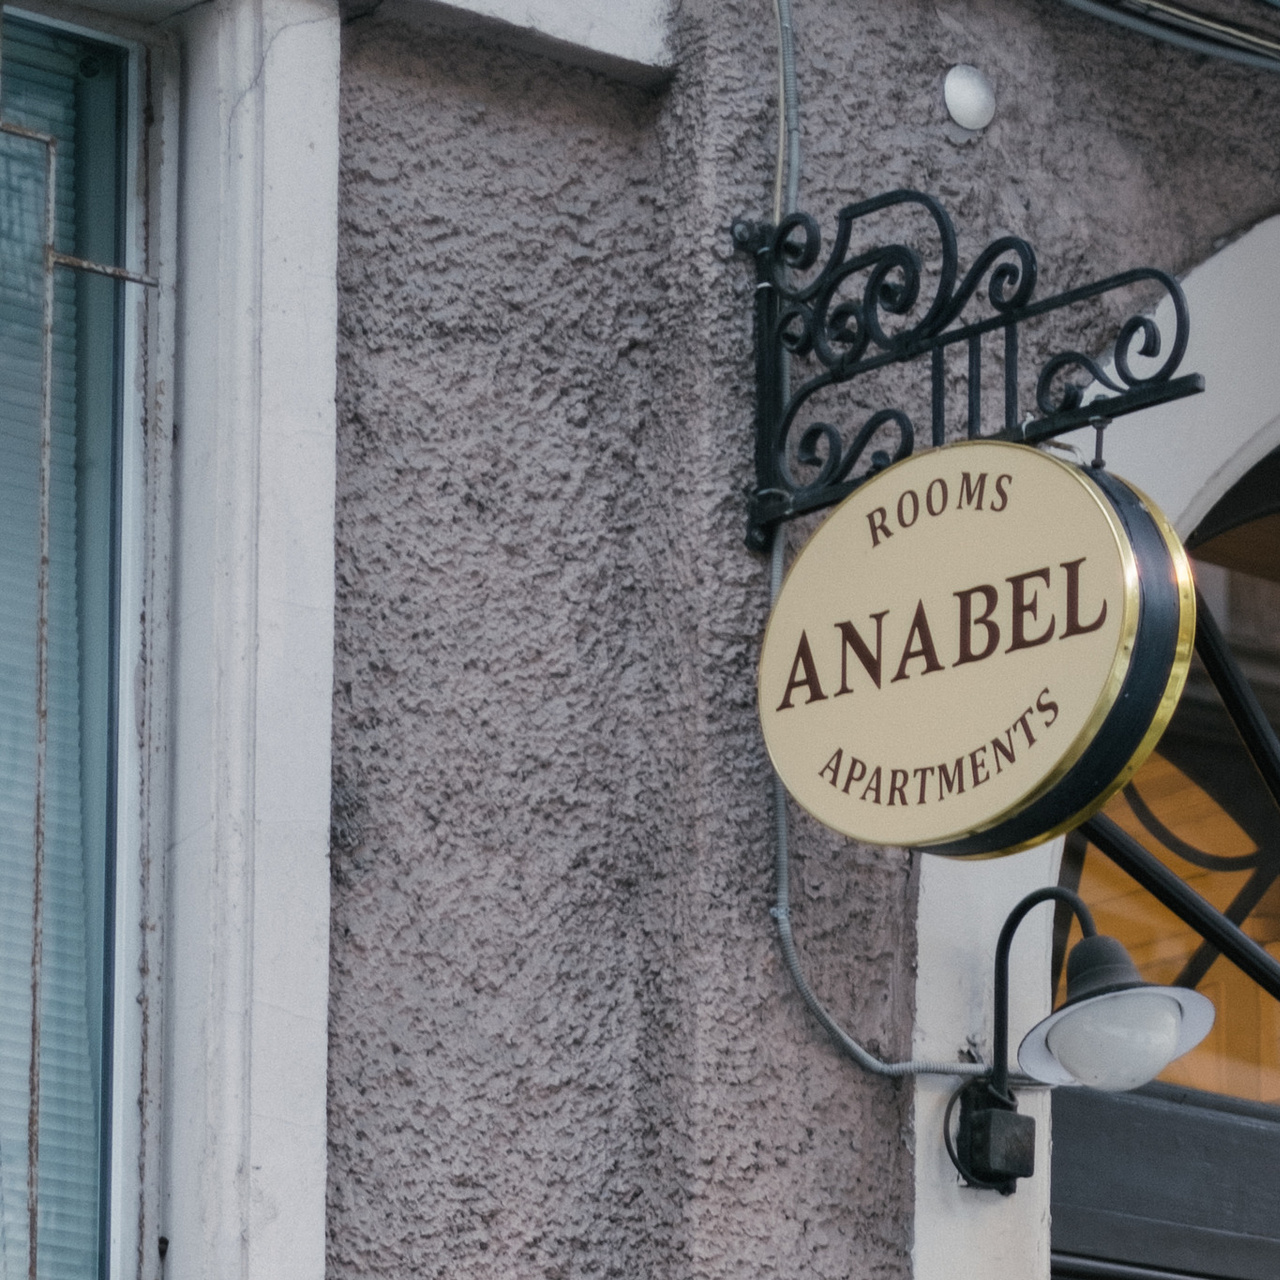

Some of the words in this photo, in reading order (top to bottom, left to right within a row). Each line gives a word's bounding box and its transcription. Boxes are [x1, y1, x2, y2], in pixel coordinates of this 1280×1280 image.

[866, 472, 1013, 548] ROOMS
[775, 556, 1108, 712] ANABEL
[818, 687, 1060, 807] APARTMENTS
